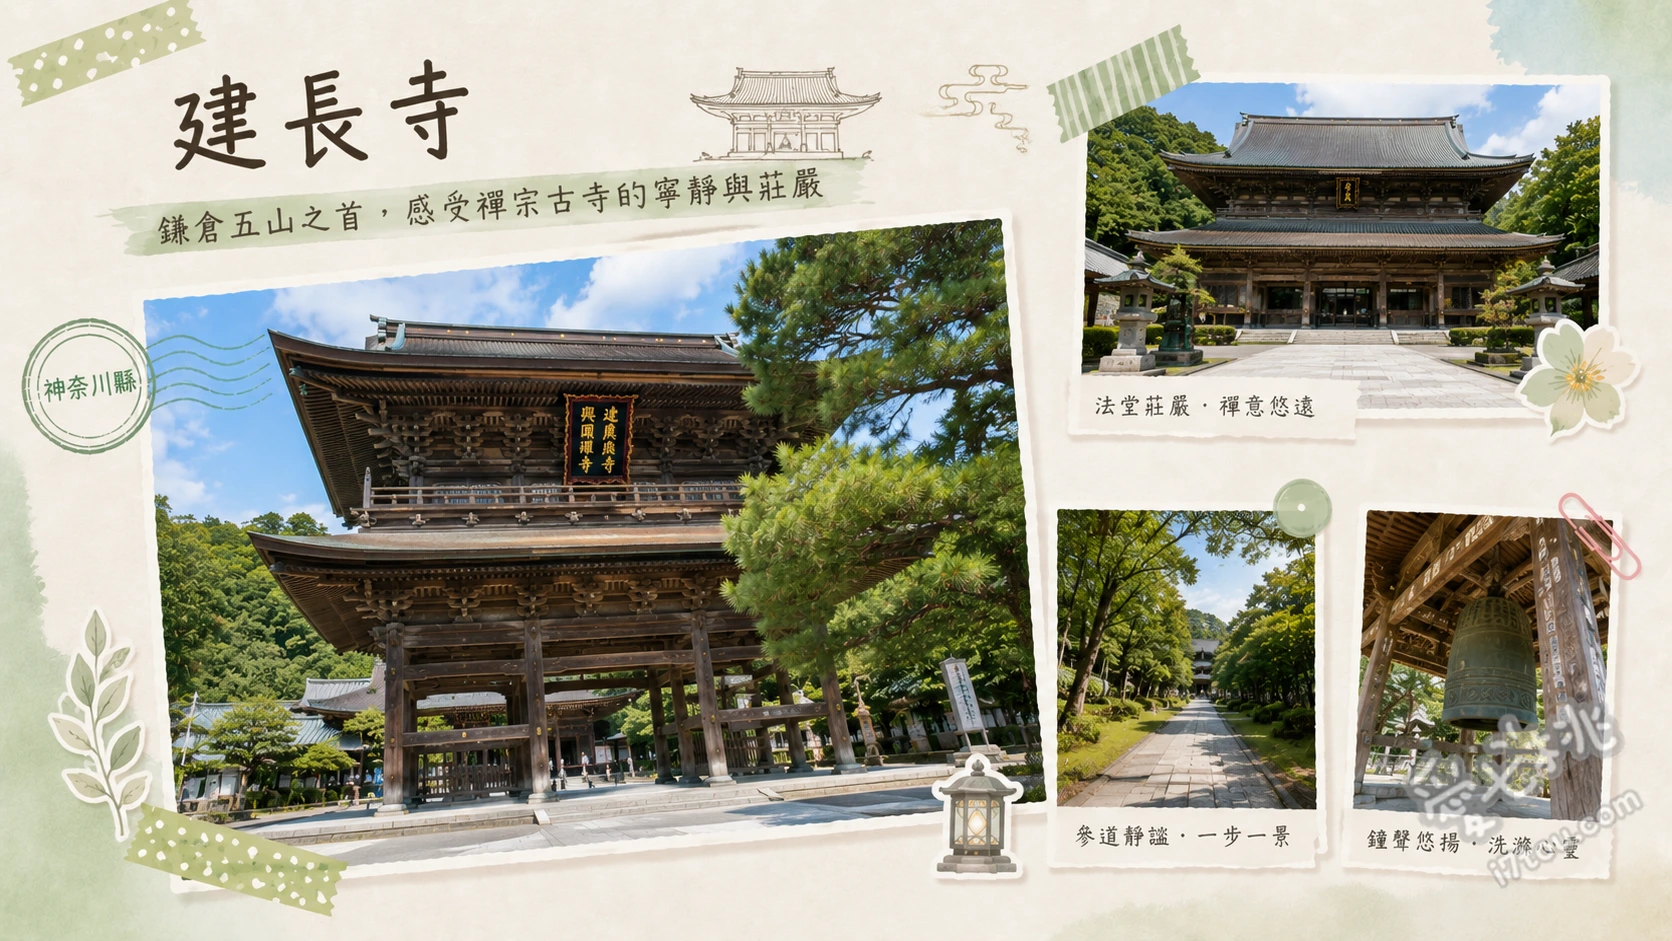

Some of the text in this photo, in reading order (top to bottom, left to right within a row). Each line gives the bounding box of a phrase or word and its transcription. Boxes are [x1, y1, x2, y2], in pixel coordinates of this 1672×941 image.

[173, 59, 469, 171] 建長寺
[43, 368, 137, 403] 神奈川縣
